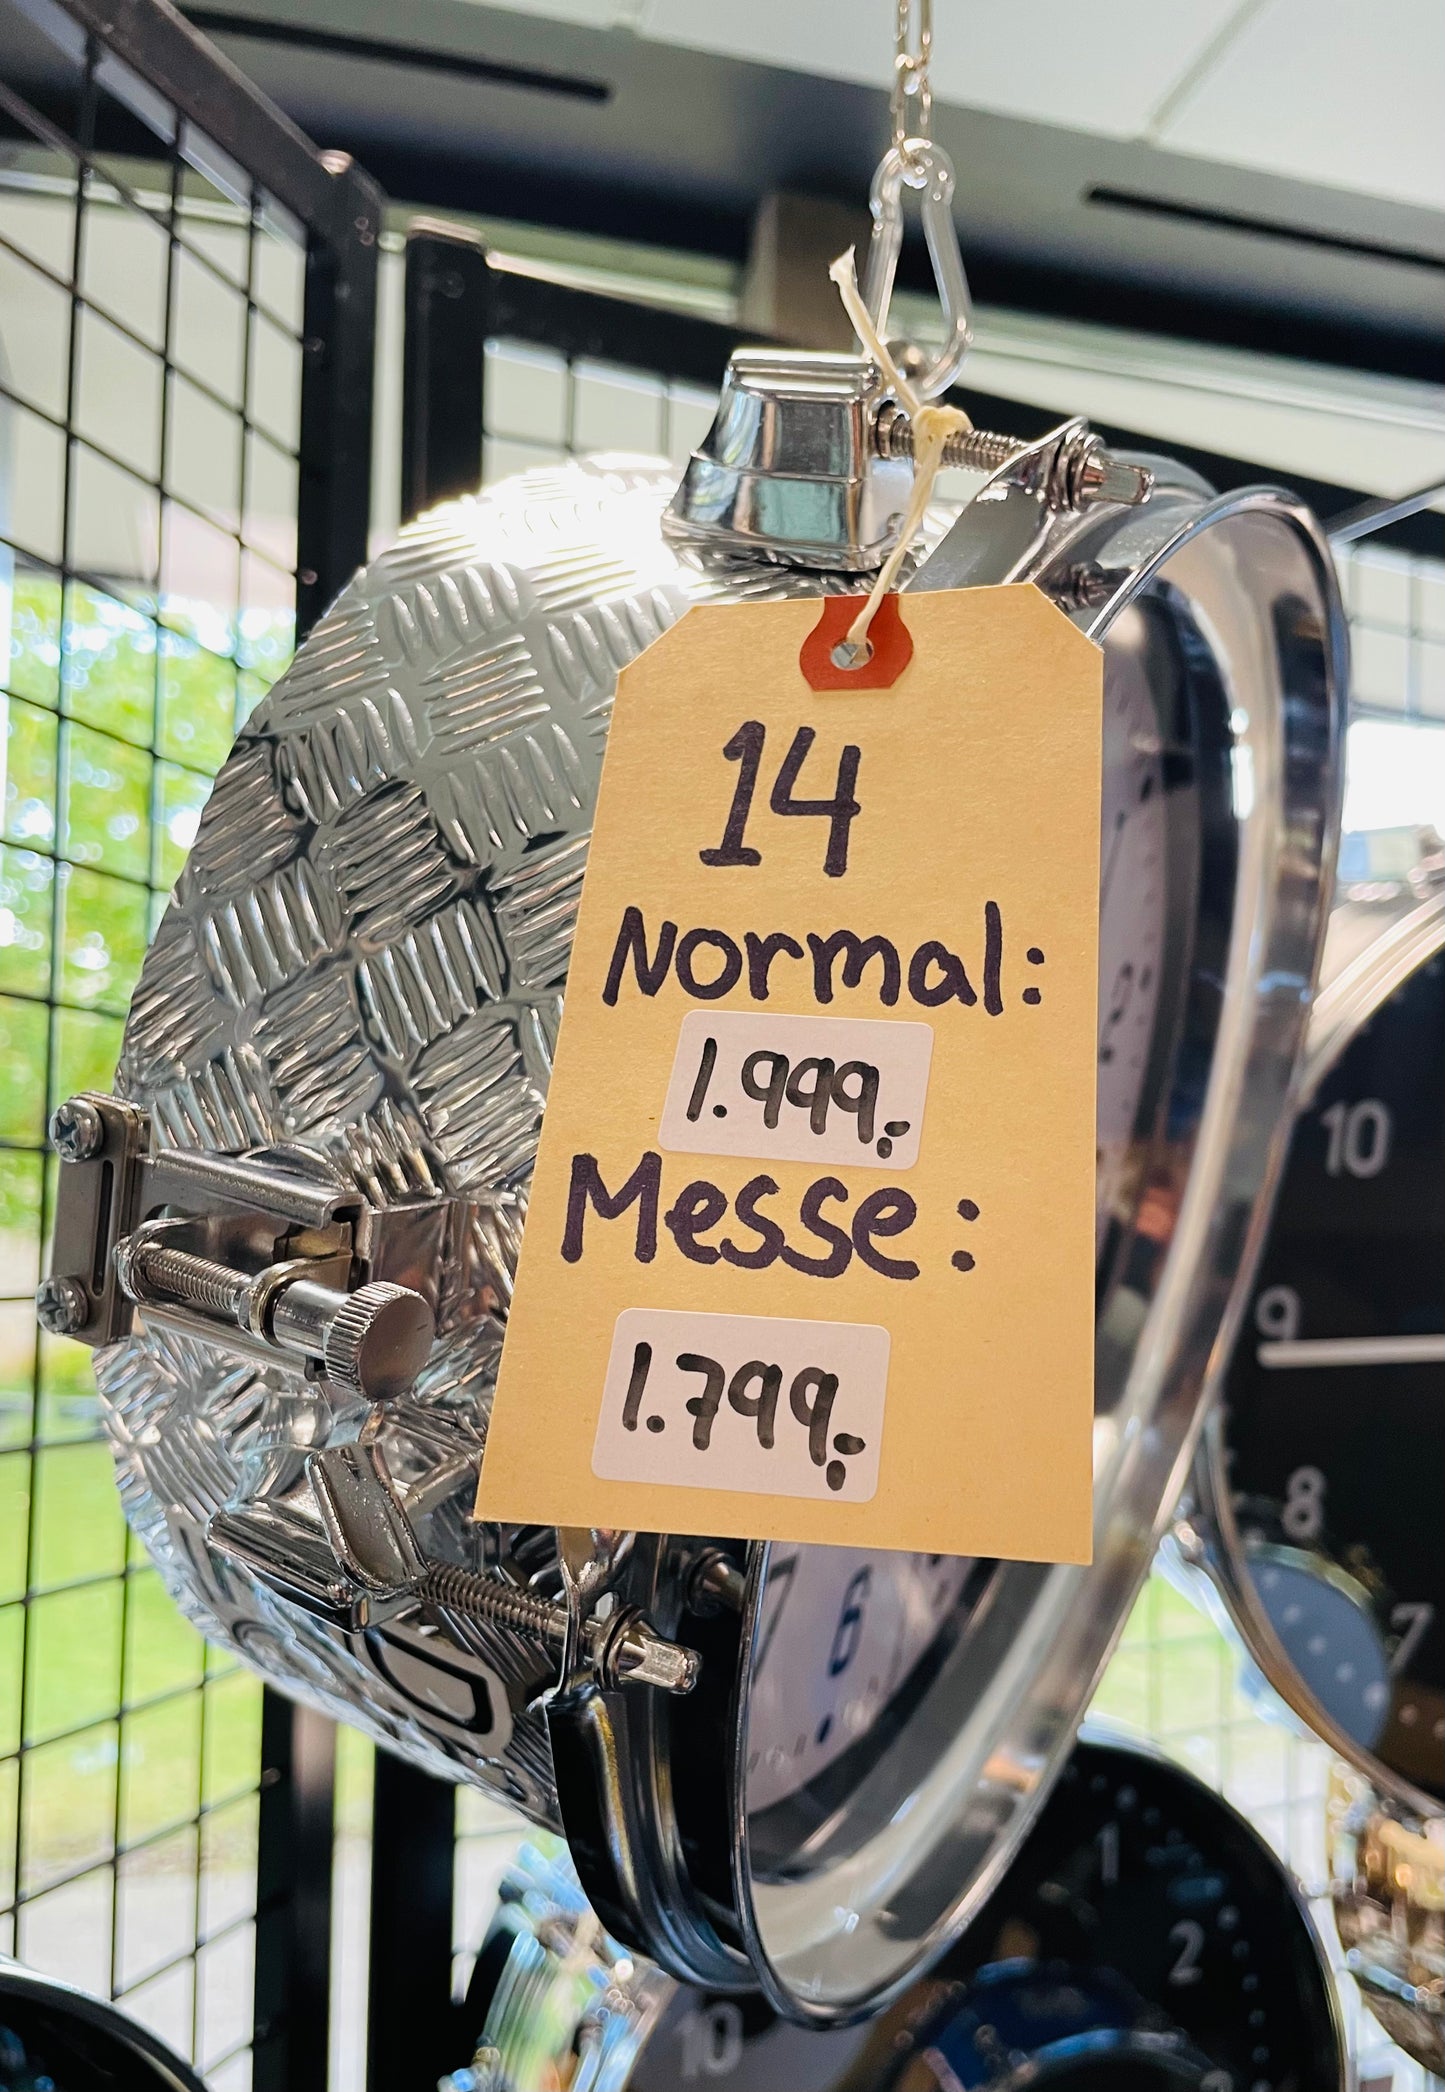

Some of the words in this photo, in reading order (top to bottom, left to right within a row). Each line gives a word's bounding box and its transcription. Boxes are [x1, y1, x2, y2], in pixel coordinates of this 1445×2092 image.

[698, 720, 862, 878] 14
[601, 900, 1045, 1017] Normal:
[1320, 1099, 1391, 1178] 10
[560, 1151, 981, 1281] Messe:
[1256, 1286, 1299, 1340] 9
[1282, 1465, 1327, 1538] 8
[1390, 1602, 1433, 1673] 7
[1096, 1822, 1120, 1886] 1
[1168, 1918, 1204, 1986] 2
[675, 2002, 743, 2077] 10
